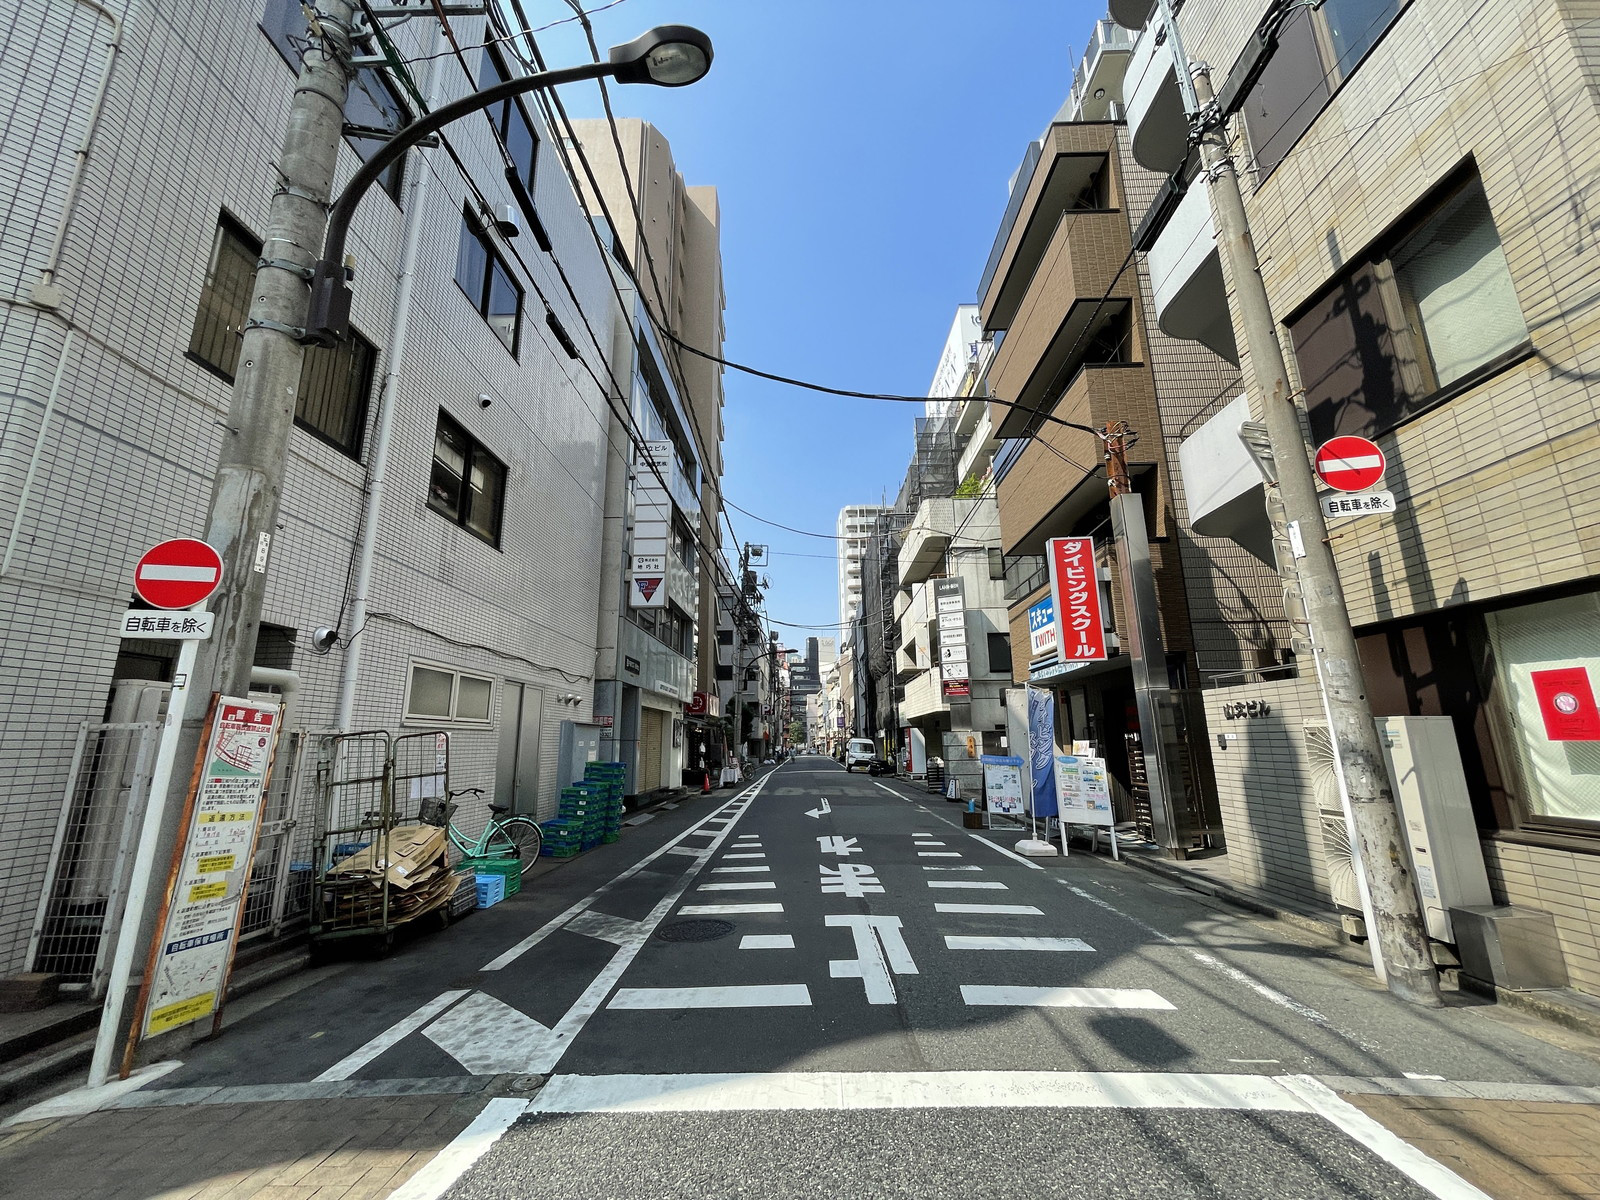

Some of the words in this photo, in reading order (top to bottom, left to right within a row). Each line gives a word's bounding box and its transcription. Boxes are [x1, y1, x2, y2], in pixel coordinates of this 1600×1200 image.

[1328, 497, 1390, 513] 自転車を除く
[1062, 541, 1096, 657] ダイビングスクール
[125, 617, 207, 634] 自転車を除く
[1030, 608, 1055, 629] スキュー
